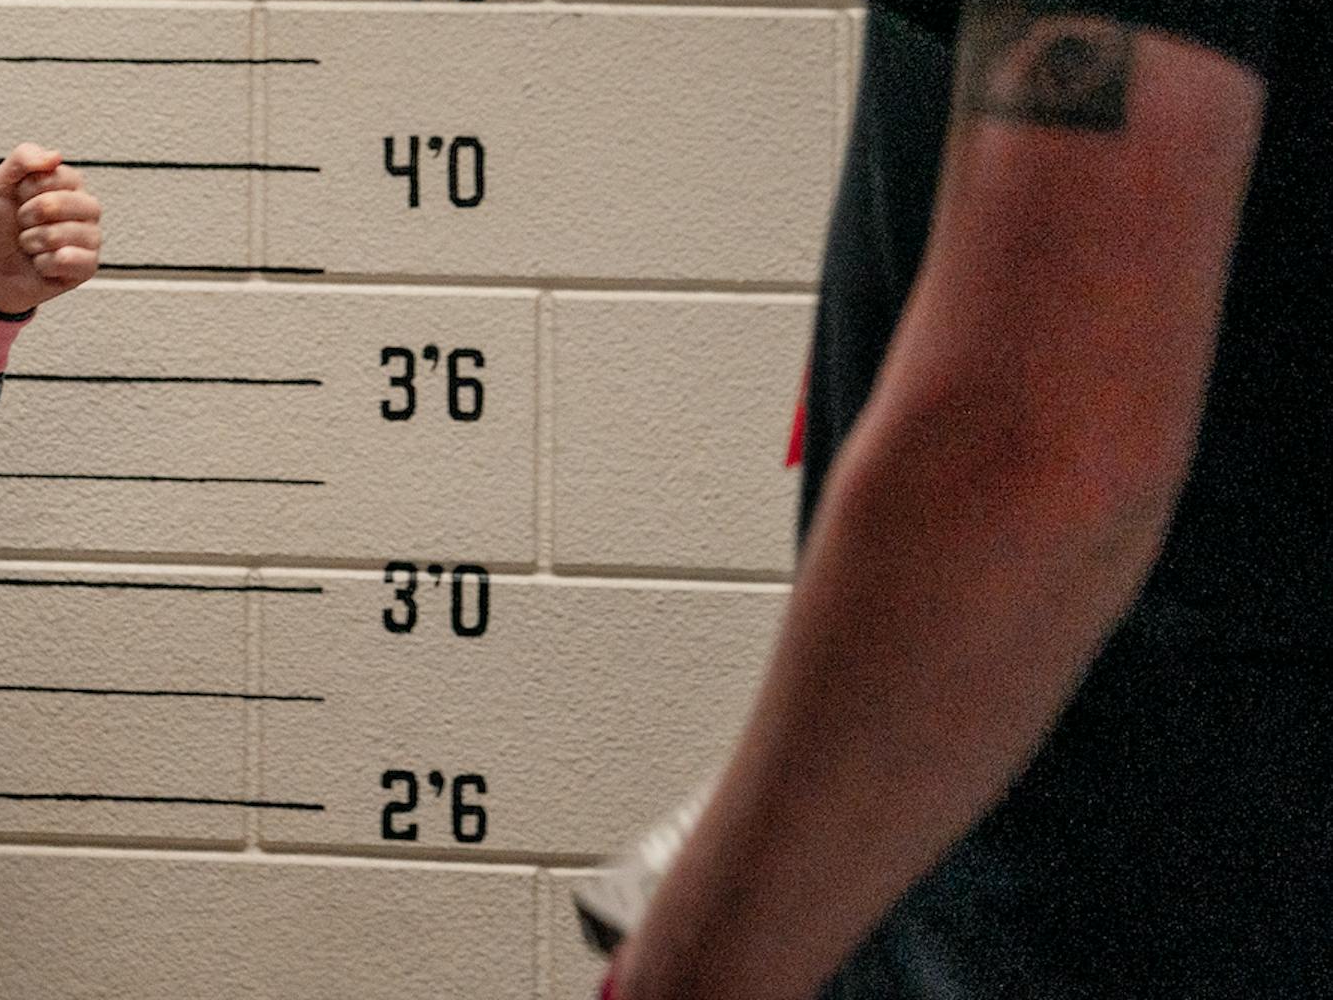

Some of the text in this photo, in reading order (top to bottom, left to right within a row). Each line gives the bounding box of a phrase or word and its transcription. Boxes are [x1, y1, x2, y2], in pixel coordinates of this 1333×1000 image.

[382, 135, 487, 209] 4'0
[380, 344, 486, 422] 3'6
[381, 560, 491, 638] 3'0
[380, 769, 489, 844] 2'6
